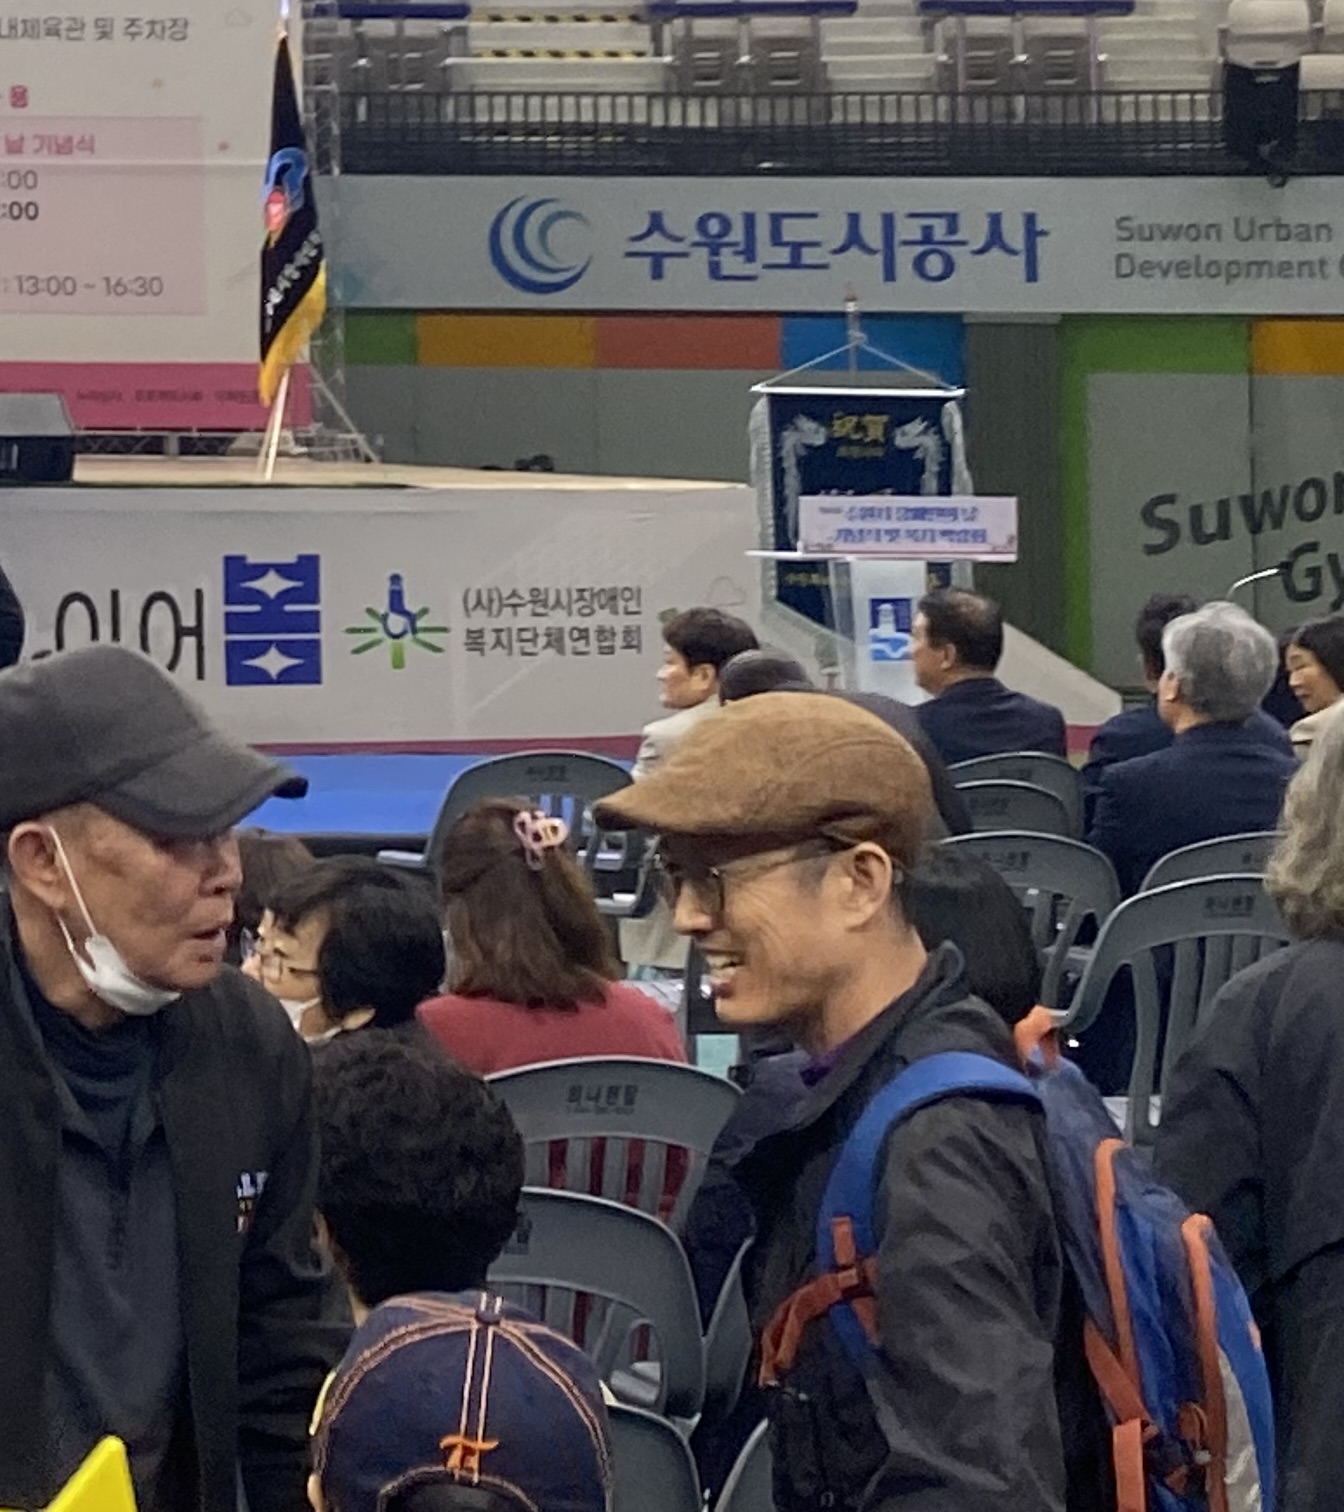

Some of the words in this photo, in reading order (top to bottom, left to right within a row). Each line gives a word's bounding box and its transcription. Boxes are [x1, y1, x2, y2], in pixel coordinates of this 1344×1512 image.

[94, 17, 115, 41] 및
[123, 17, 190, 42] 주차장
[4, 134, 25, 155] 날
[32, 134, 95, 155] 기념식
[1115, 217, 1223, 242] Suwon
[1233, 217, 1332, 242] Urban
[624, 210, 1050, 283] 수원도시공사
[1115, 253, 1329, 286] Development
[16, 275, 77, 296] 13:00
[102, 276, 163, 297] 16:30
[462, 586, 642, 618] (사)수원시장애인
[464, 625, 642, 656] 복지단체연합회
